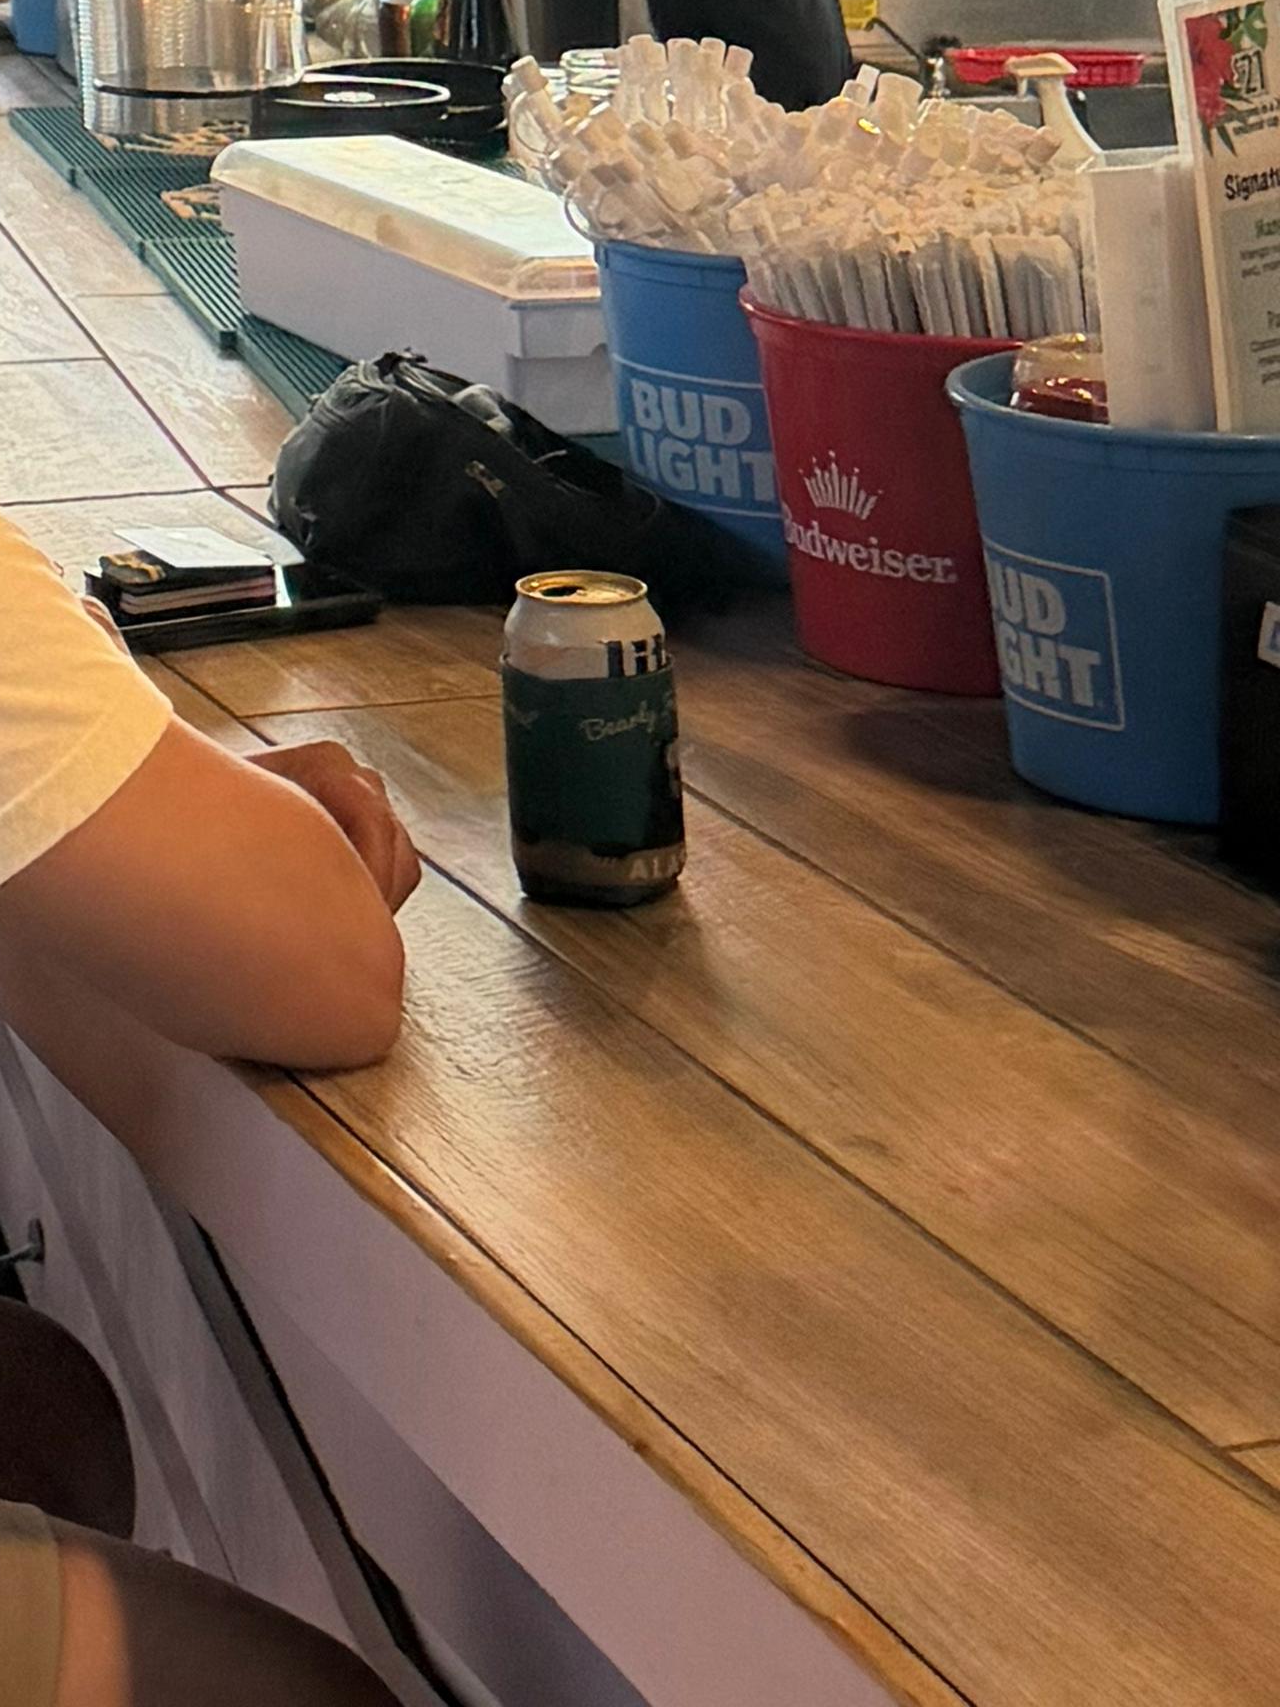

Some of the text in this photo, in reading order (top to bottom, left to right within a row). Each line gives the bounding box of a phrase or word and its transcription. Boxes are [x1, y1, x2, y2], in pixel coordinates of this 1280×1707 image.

[631, 377, 752, 448] BUD
[627, 425, 777, 503] LIGHT
[988, 559, 1067, 636] UD
[996, 620, 1102, 708] GHT
